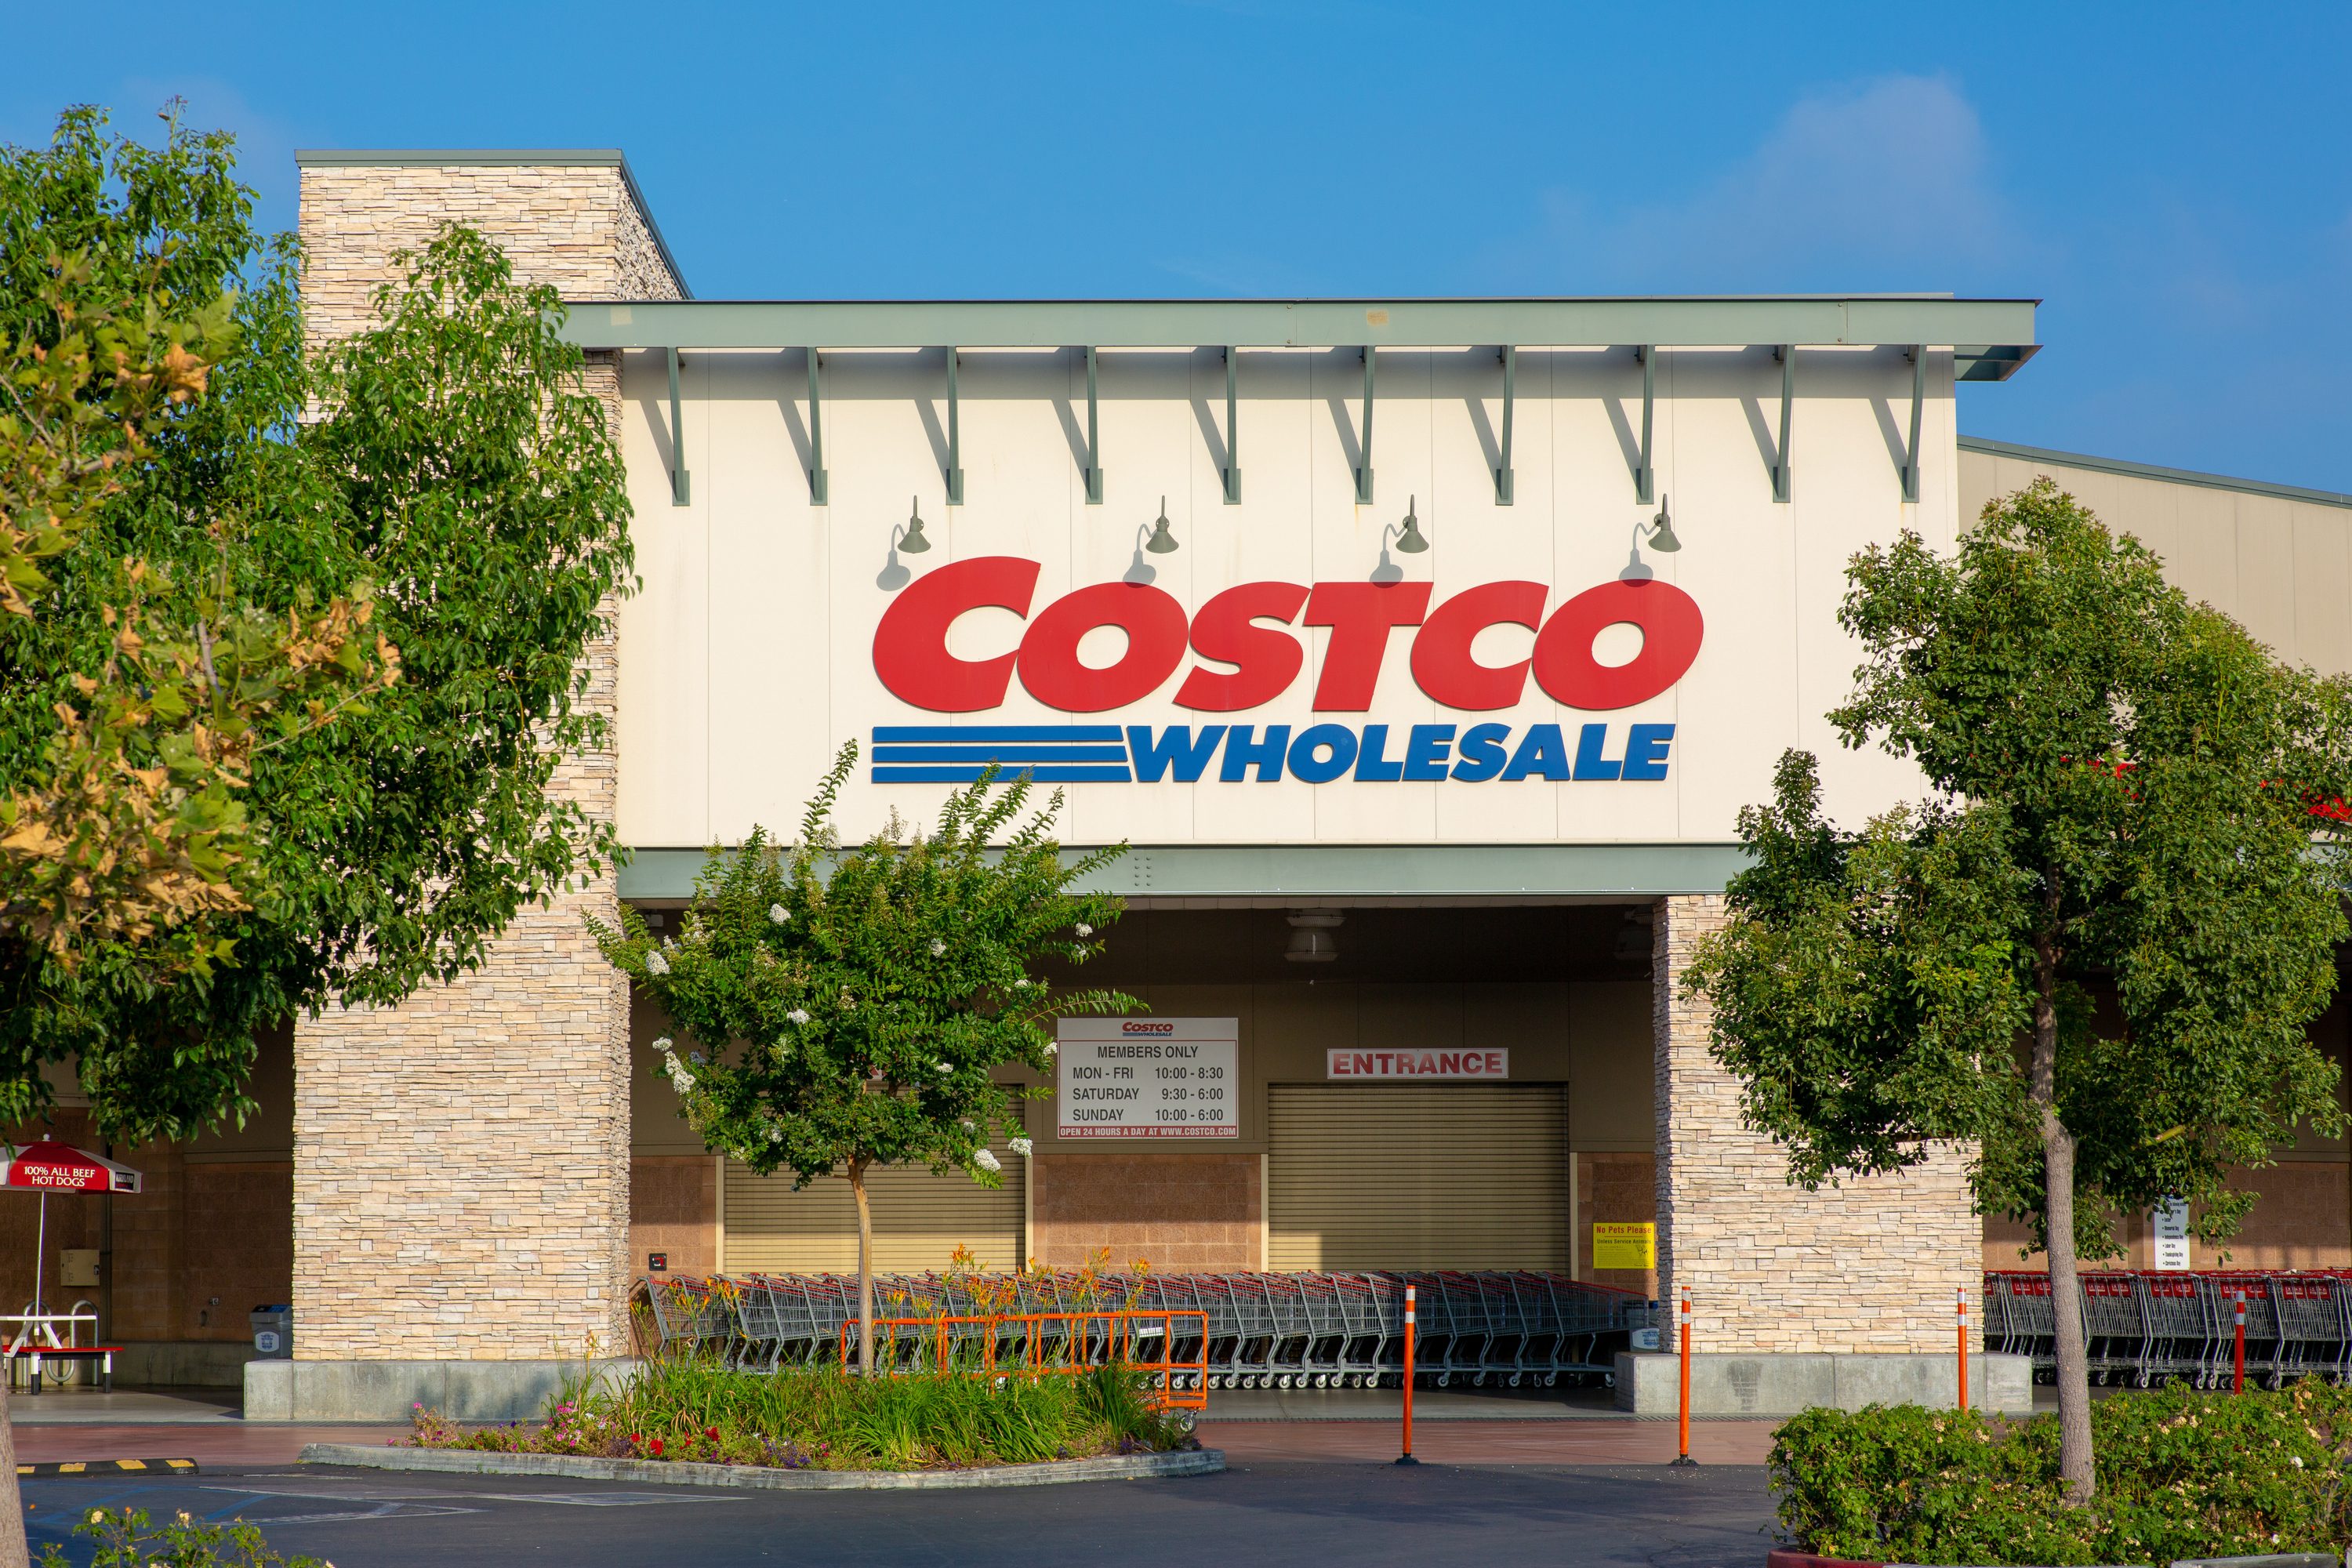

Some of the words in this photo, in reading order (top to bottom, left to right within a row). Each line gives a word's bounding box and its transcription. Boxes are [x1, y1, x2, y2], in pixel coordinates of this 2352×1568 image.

[872, 556, 1704, 713] COSTCO
[1126, 724, 1676, 784] WHOLESALE
[1122, 1022, 1174, 1033] COSTCO
[1098, 1046, 1162, 1058] MEMBERS
[1165, 1046, 1199, 1058] ONLY
[1334, 1053, 1503, 1074] ENTRANCE
[1073, 1067, 1102, 1079] MON
[1113, 1067, 1134, 1079] FRI
[1155, 1067, 1187, 1079] 10:00
[1198, 1067, 1223, 1079] 8:30
[1073, 1088, 1140, 1100] SATURDAY
[1161, 1088, 1187, 1100] 9:30
[1198, 1088, 1223, 1100] 6:00
[1073, 1109, 1124, 1121] SUNDAY
[1155, 1109, 1187, 1121] 10:00
[1198, 1109, 1223, 1121] 6:00
[1060, 1127, 1081, 1136] OPEN
[1083, 1127, 1093, 1136] 24
[1094, 1127, 1121, 1136] HOURS
[1123, 1127, 1129, 1136] A
[1131, 1127, 1146, 1136] DAY
[1148, 1127, 1158, 1136] AT
[1160, 1127, 1236, 1136] WWW.COSTCO.COM
[24, 1166, 48, 1176] 100%
[51, 1167, 70, 1177] ALL
[73, 1168, 96, 1178] BEEF
[31, 1175, 54, 1185] HOT
[56, 1177, 85, 1187] DOGS
